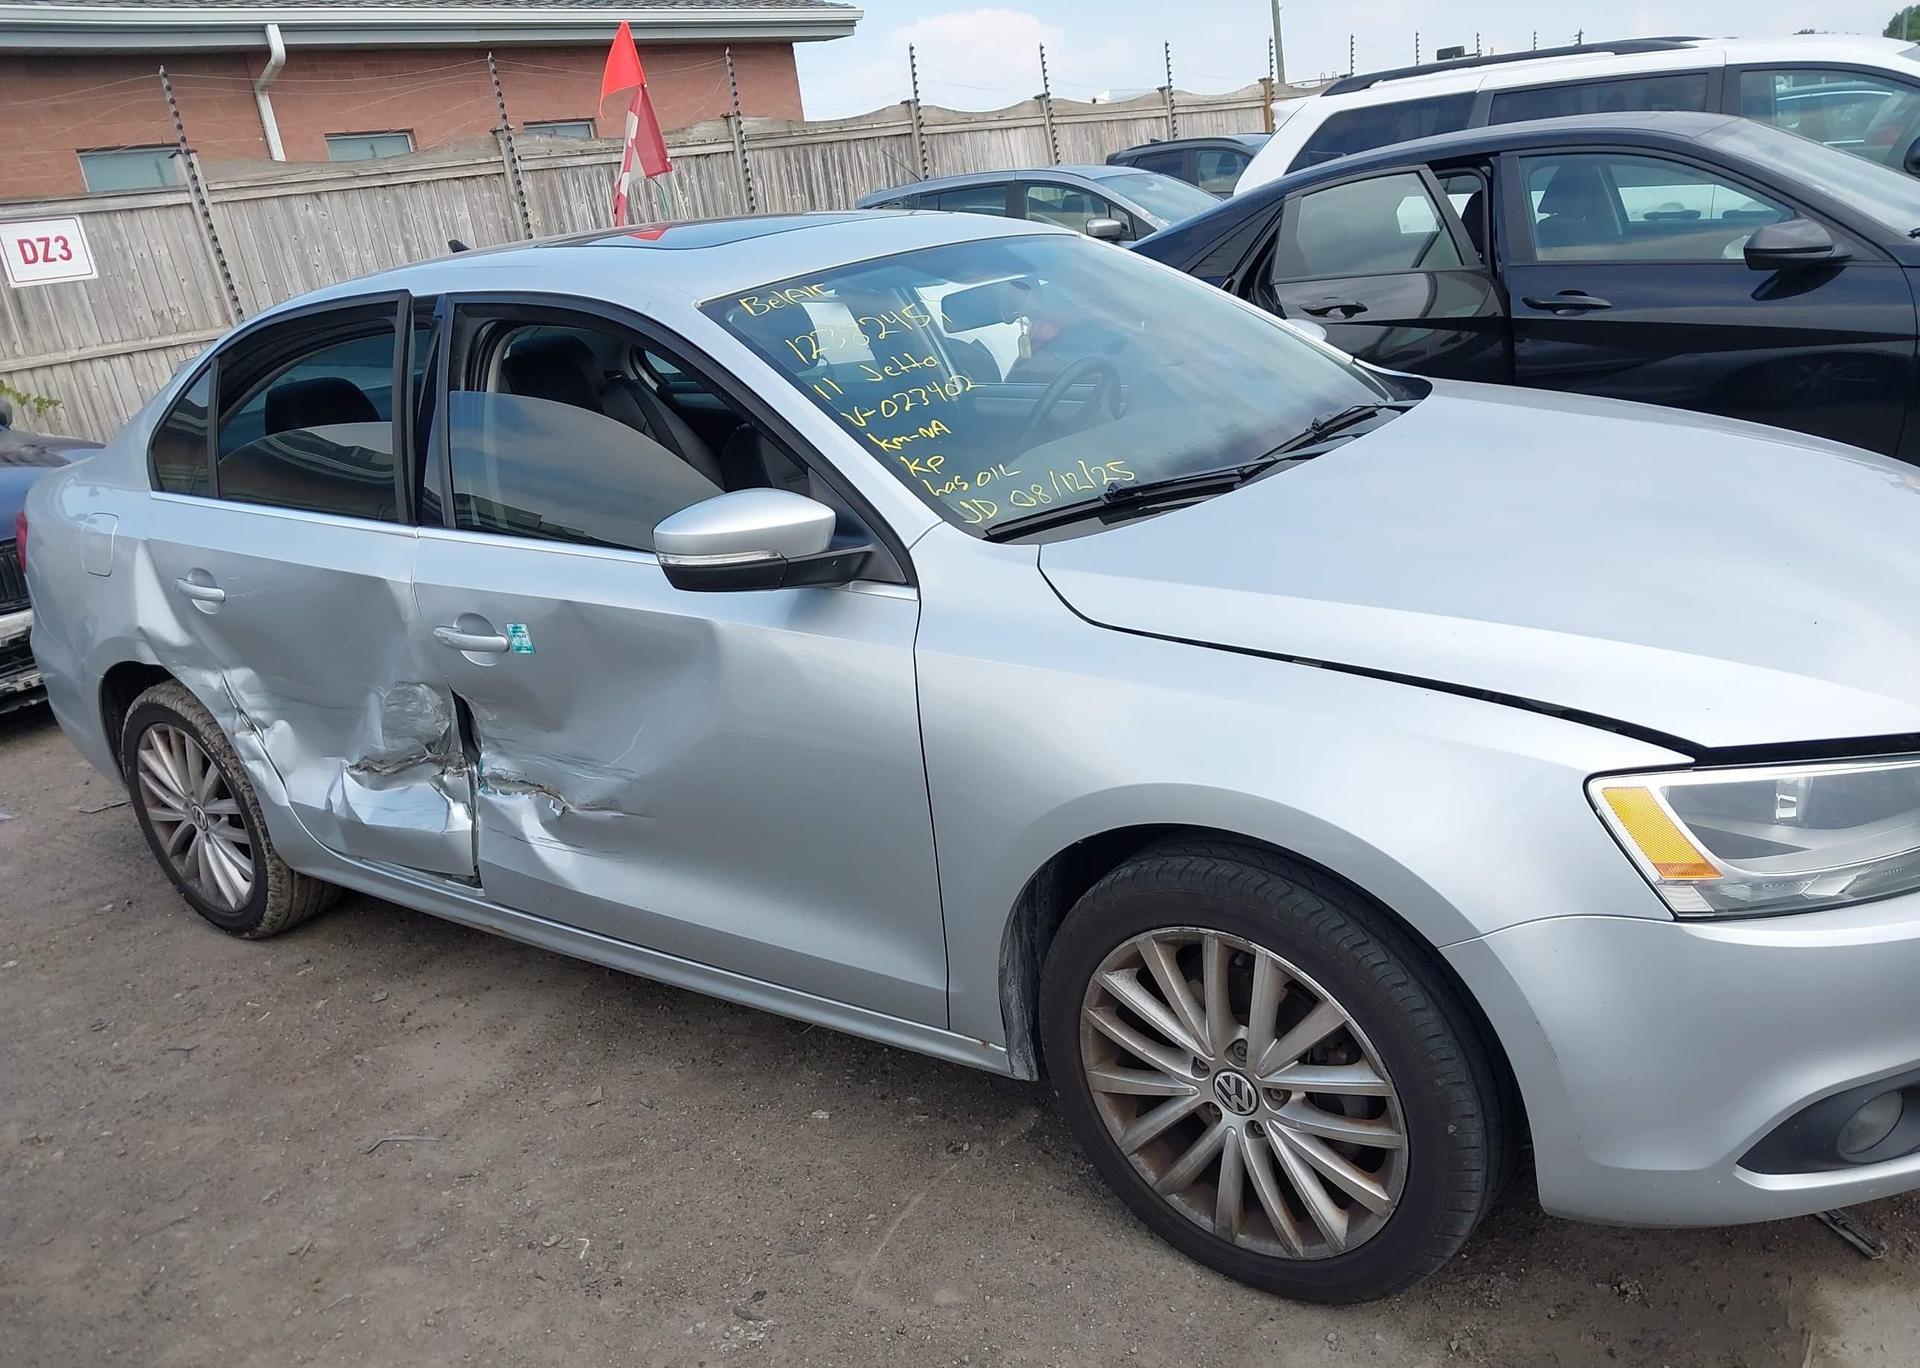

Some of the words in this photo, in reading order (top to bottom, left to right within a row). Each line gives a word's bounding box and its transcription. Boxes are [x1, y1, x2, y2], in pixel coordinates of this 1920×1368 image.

[16, 235, 73, 265] DZ3
[859, 352, 943, 383] Jetta
[958, 497, 998, 525] JD
[1009, 459, 1136, 508] 08/12/25
